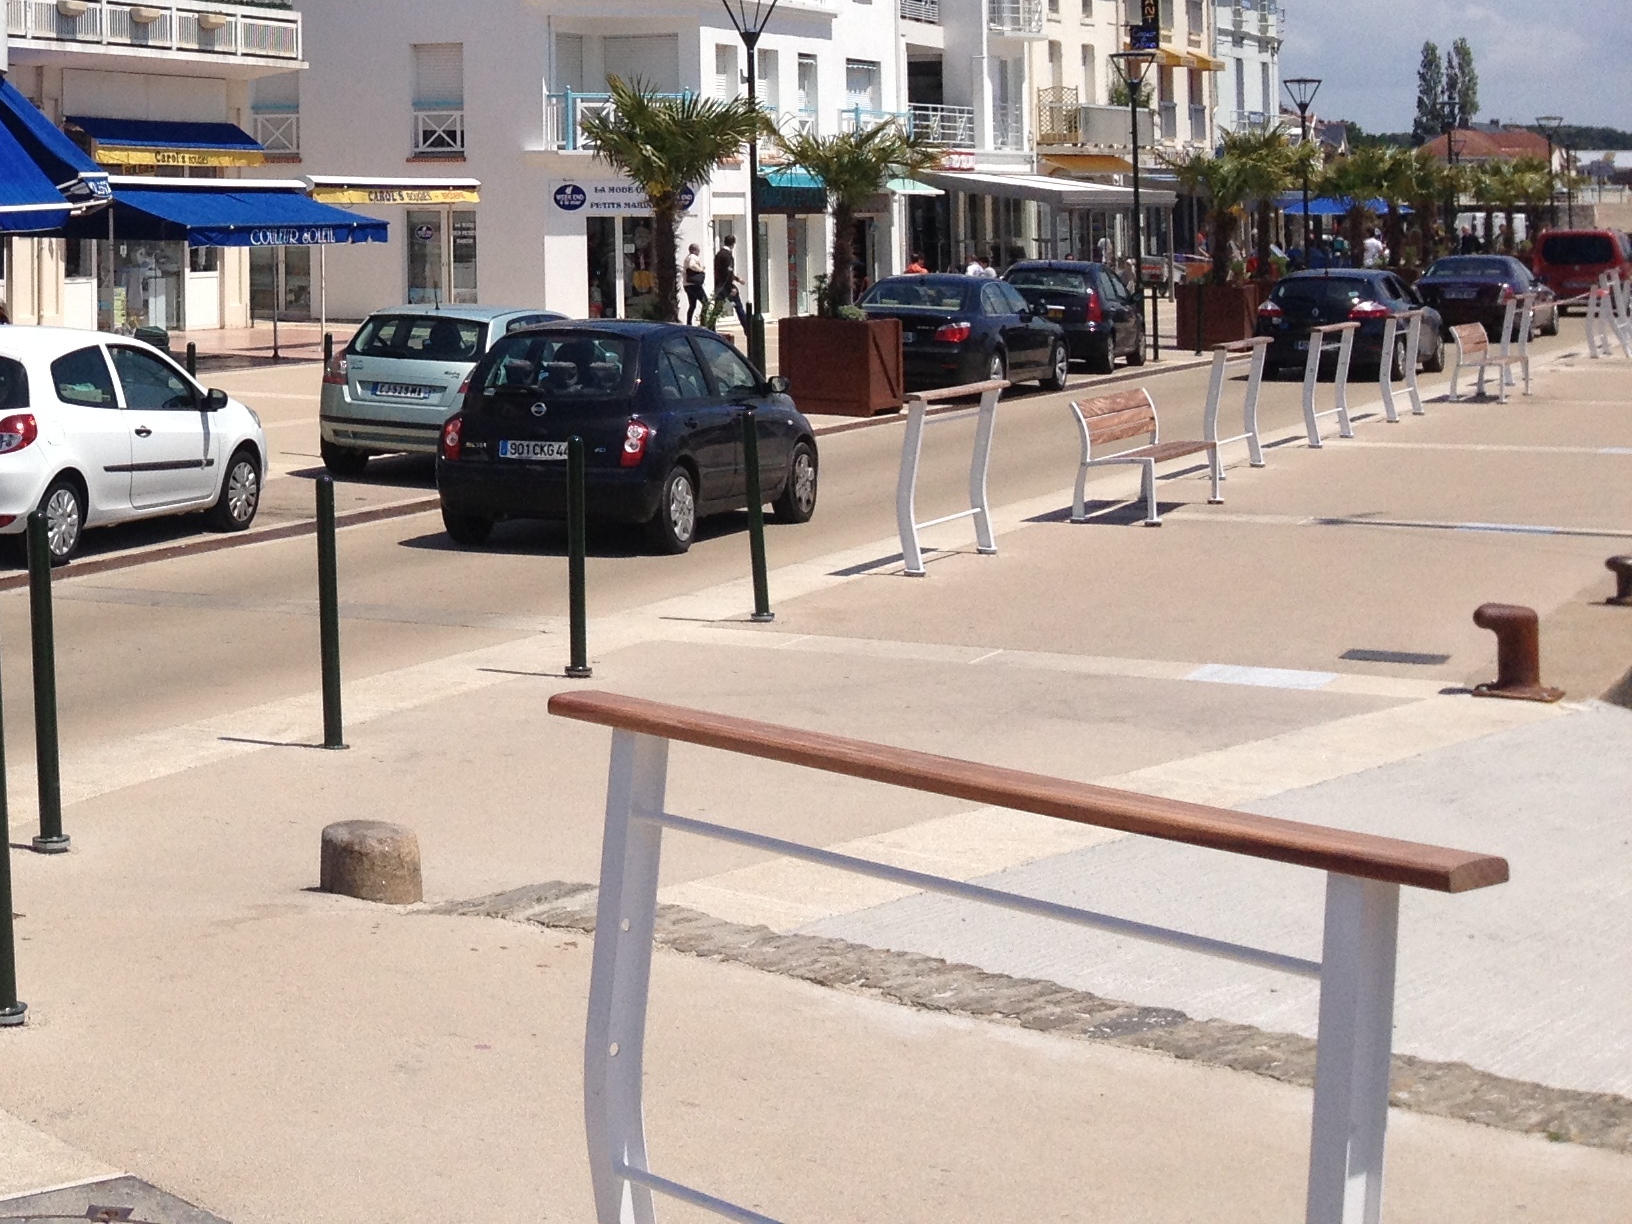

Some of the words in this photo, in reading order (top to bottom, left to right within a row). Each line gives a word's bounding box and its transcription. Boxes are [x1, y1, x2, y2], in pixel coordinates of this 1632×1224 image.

[368, 190, 405, 202] CAROL'S
[250, 229, 299, 246] COULEUR
[302, 228, 336, 244] SOLEIL
[510, 443, 530, 457] 901
[532, 444, 554, 458] CKG
